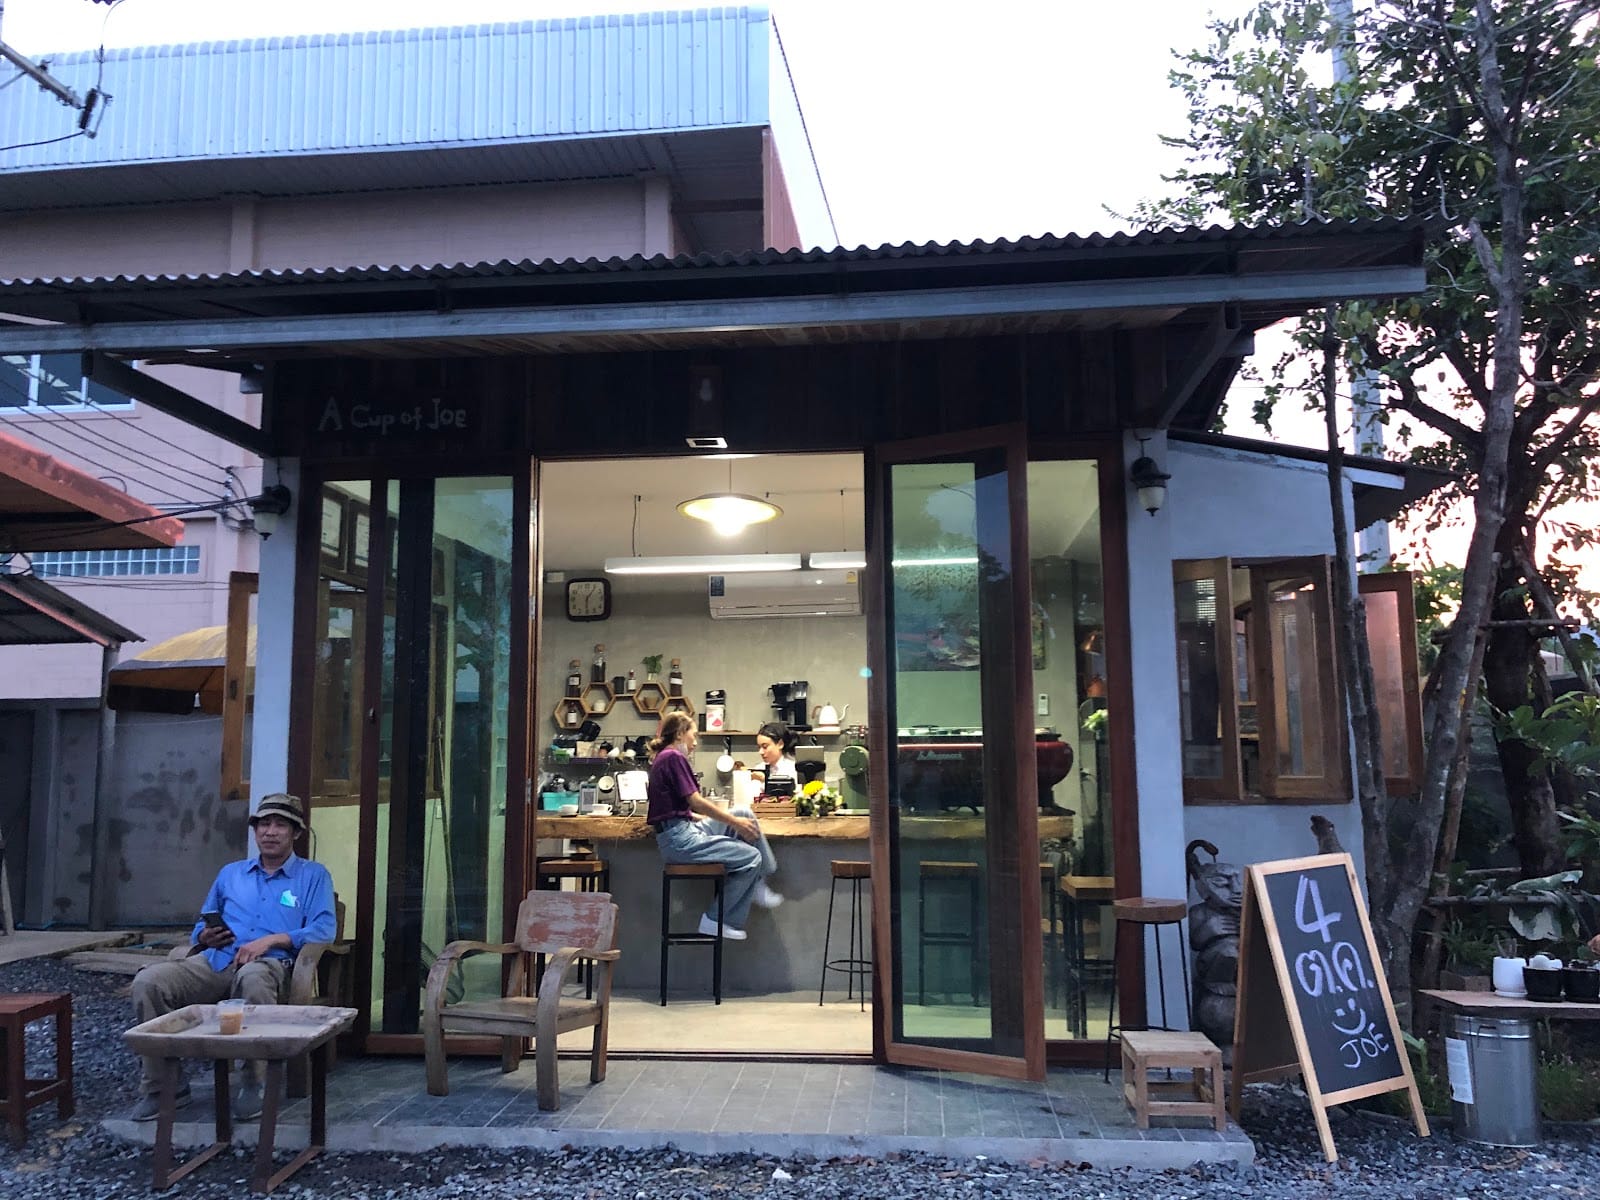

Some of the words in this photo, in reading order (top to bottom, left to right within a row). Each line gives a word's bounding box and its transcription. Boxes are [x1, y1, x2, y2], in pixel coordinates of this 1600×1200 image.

[317, 397, 343, 431] A
[351, 405, 395, 435] Cup
[400, 407, 424, 431] of
[1295, 874, 1342, 943] 4
[1340, 1022, 1390, 1069] JOE
